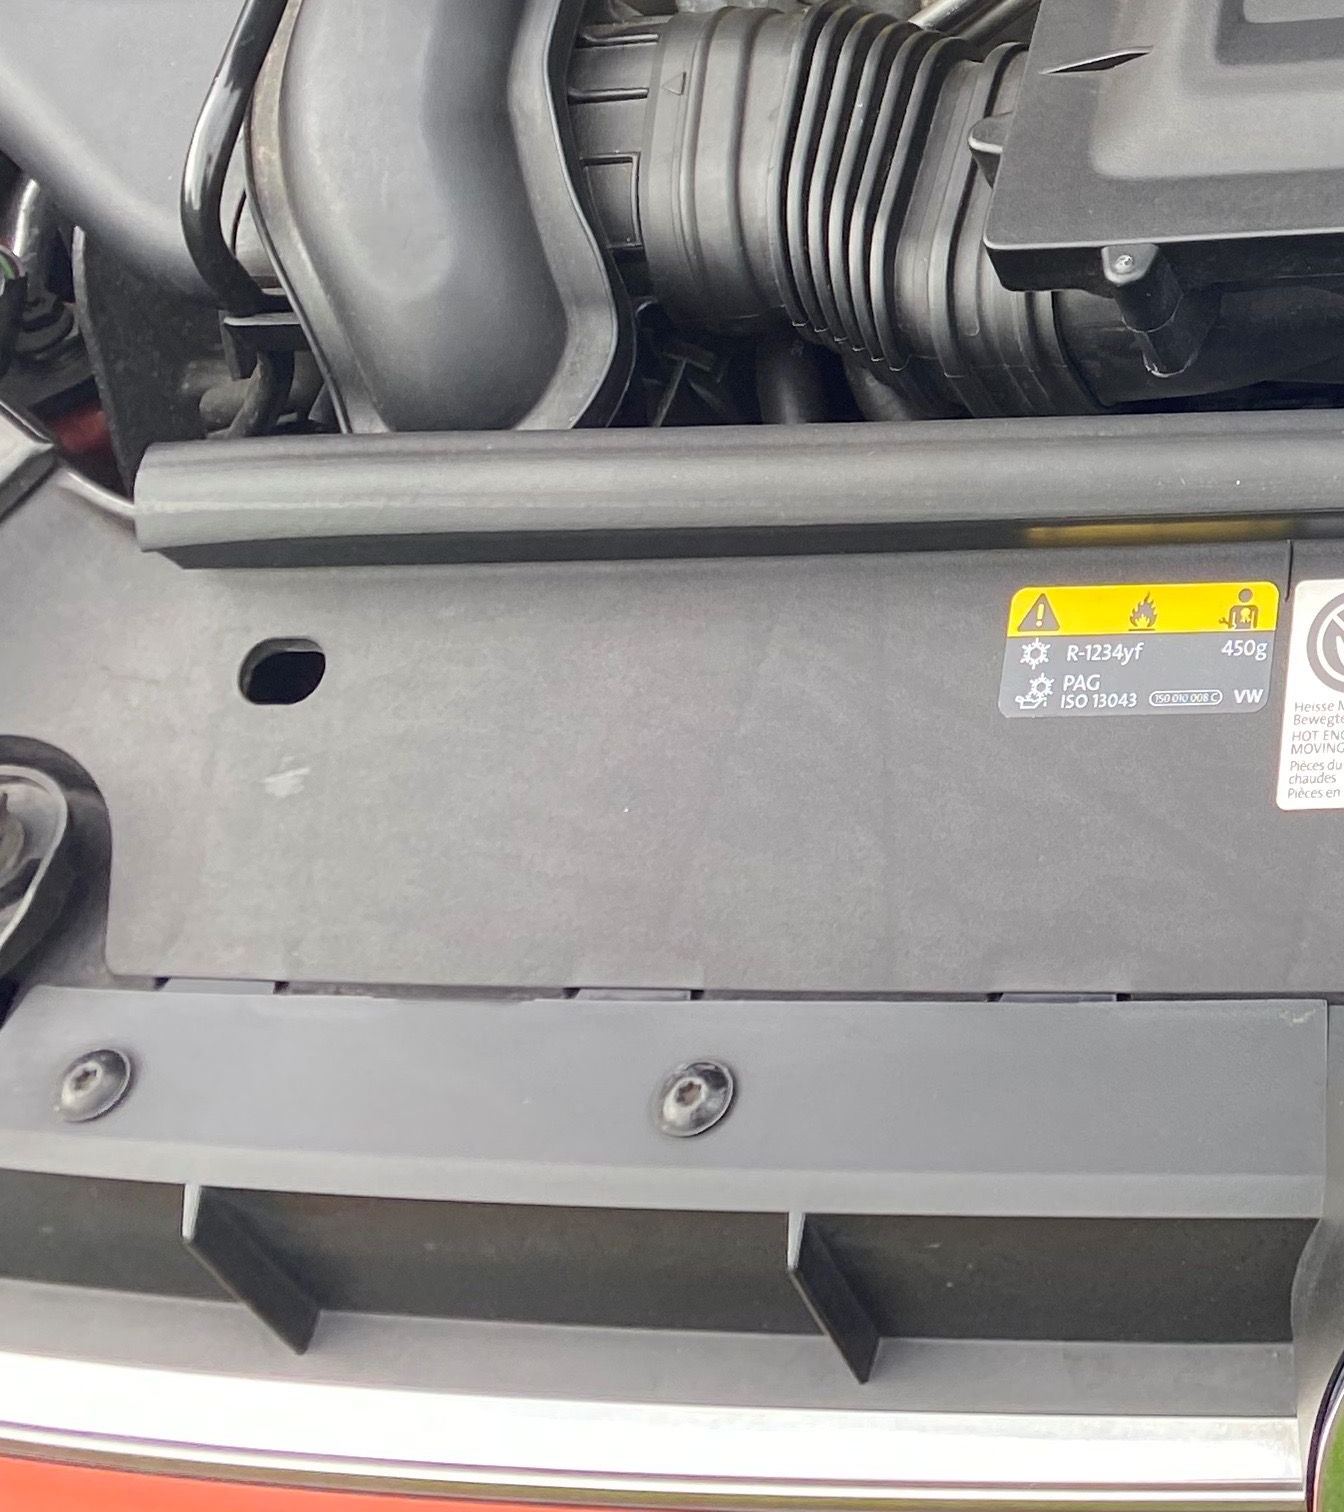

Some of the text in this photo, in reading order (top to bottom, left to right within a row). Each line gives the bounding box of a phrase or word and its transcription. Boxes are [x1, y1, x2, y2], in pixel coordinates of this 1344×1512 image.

[1066, 642, 1144, 665] R-1234yf
[1221, 639, 1268, 660] 450g
[1063, 674, 1100, 691] PAG
[1060, 692, 1137, 709] ISO 13043
[1172, 693, 1188, 703] 010
[1190, 692, 1209, 703] 008
[1211, 692, 1218, 702] C
[1234, 689, 1264, 704] VW
[1294, 701, 1335, 713] Heisse
[1292, 730, 1318, 742] HOT
[1291, 742, 1344, 755] MOVING
[1290, 760, 1325, 772] Pièces
[1327, 759, 1342, 771] du
[1288, 772, 1336, 785] chaudes
[1287, 787, 1323, 799] Pièces
[1325, 788, 1340, 799] en
